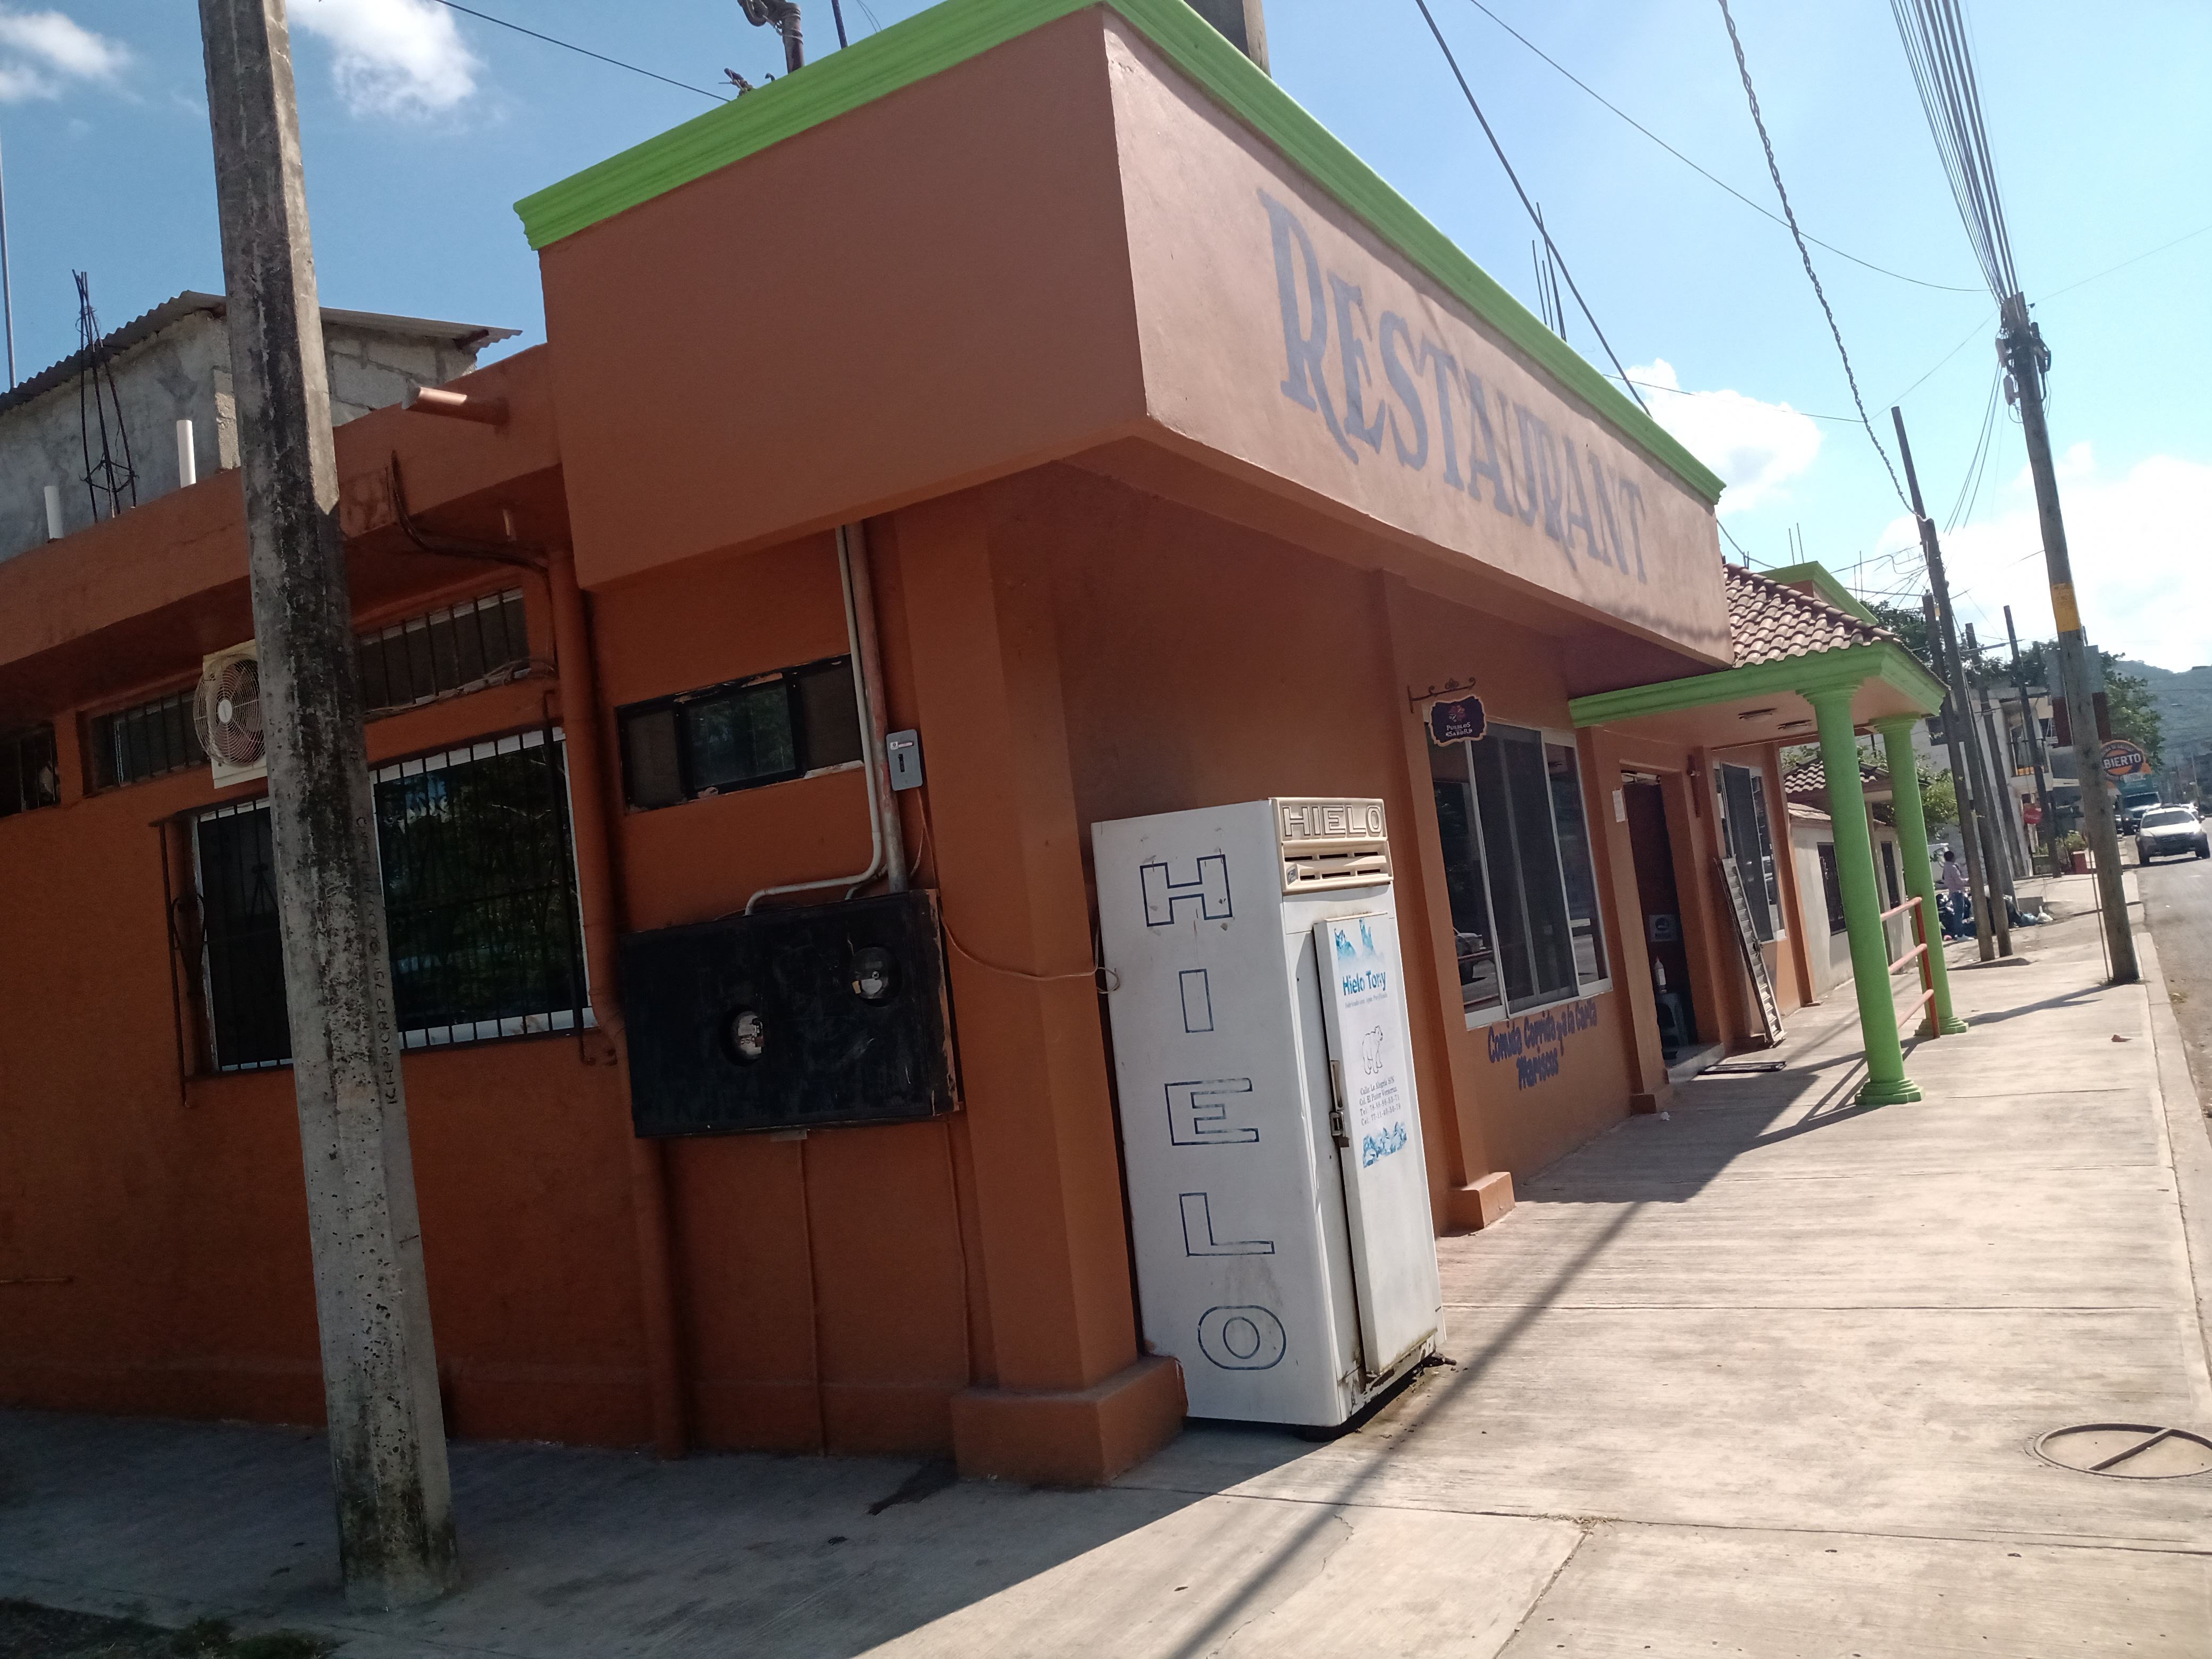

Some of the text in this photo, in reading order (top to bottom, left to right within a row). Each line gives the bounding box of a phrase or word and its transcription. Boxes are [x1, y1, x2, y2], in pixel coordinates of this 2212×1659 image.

[1256, 187, 1648, 585] RESTAURANT
[2103, 753, 2141, 769] BIERTO
[1283, 805, 1382, 837] HIELO
[1343, 970, 1386, 996] Hielo Tony
[1488, 1020, 1522, 1063] Comida
[1524, 1010, 1556, 1049] Corrida
[1516, 1045, 1559, 1091] Mariscos
[1140, 854, 1286, 1370] HIELO
